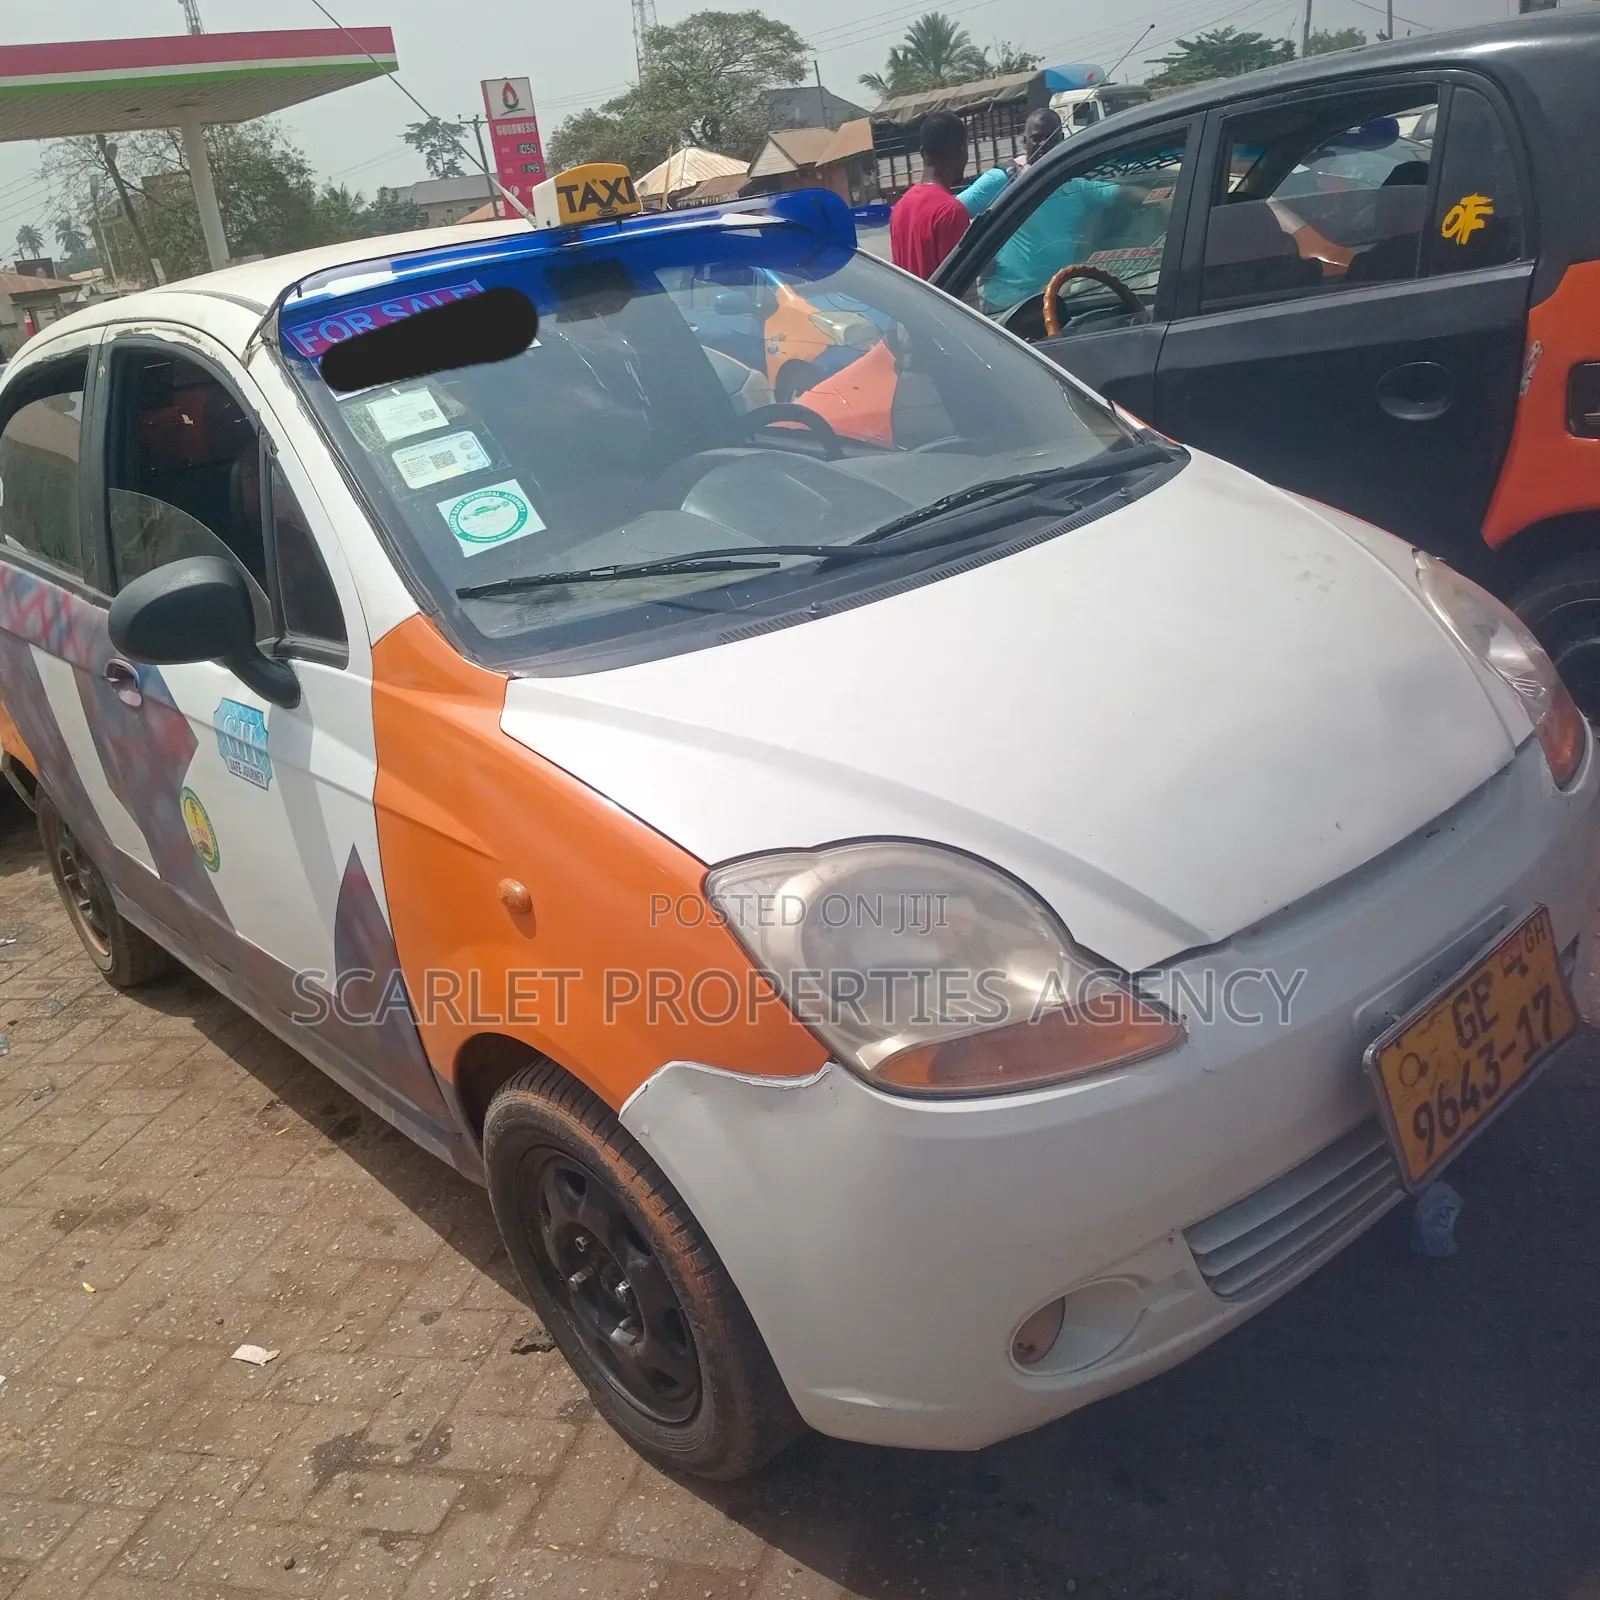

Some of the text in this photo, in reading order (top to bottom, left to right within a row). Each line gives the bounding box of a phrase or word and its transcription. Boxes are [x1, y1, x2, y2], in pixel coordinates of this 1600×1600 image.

[496, 122, 537, 136] GOODNESS
[557, 177, 637, 213] TAXI
[292, 312, 379, 353] FOR
[452, 502, 465, 516] EAST
[464, 491, 500, 504] MUNICIPAL
[502, 493, 526, 513] ASSEMBLY
[229, 757, 265, 786] SAFE JOURNEY
[1523, 914, 1547, 953] GH
[1412, 984, 1552, 1161] 9643-17
